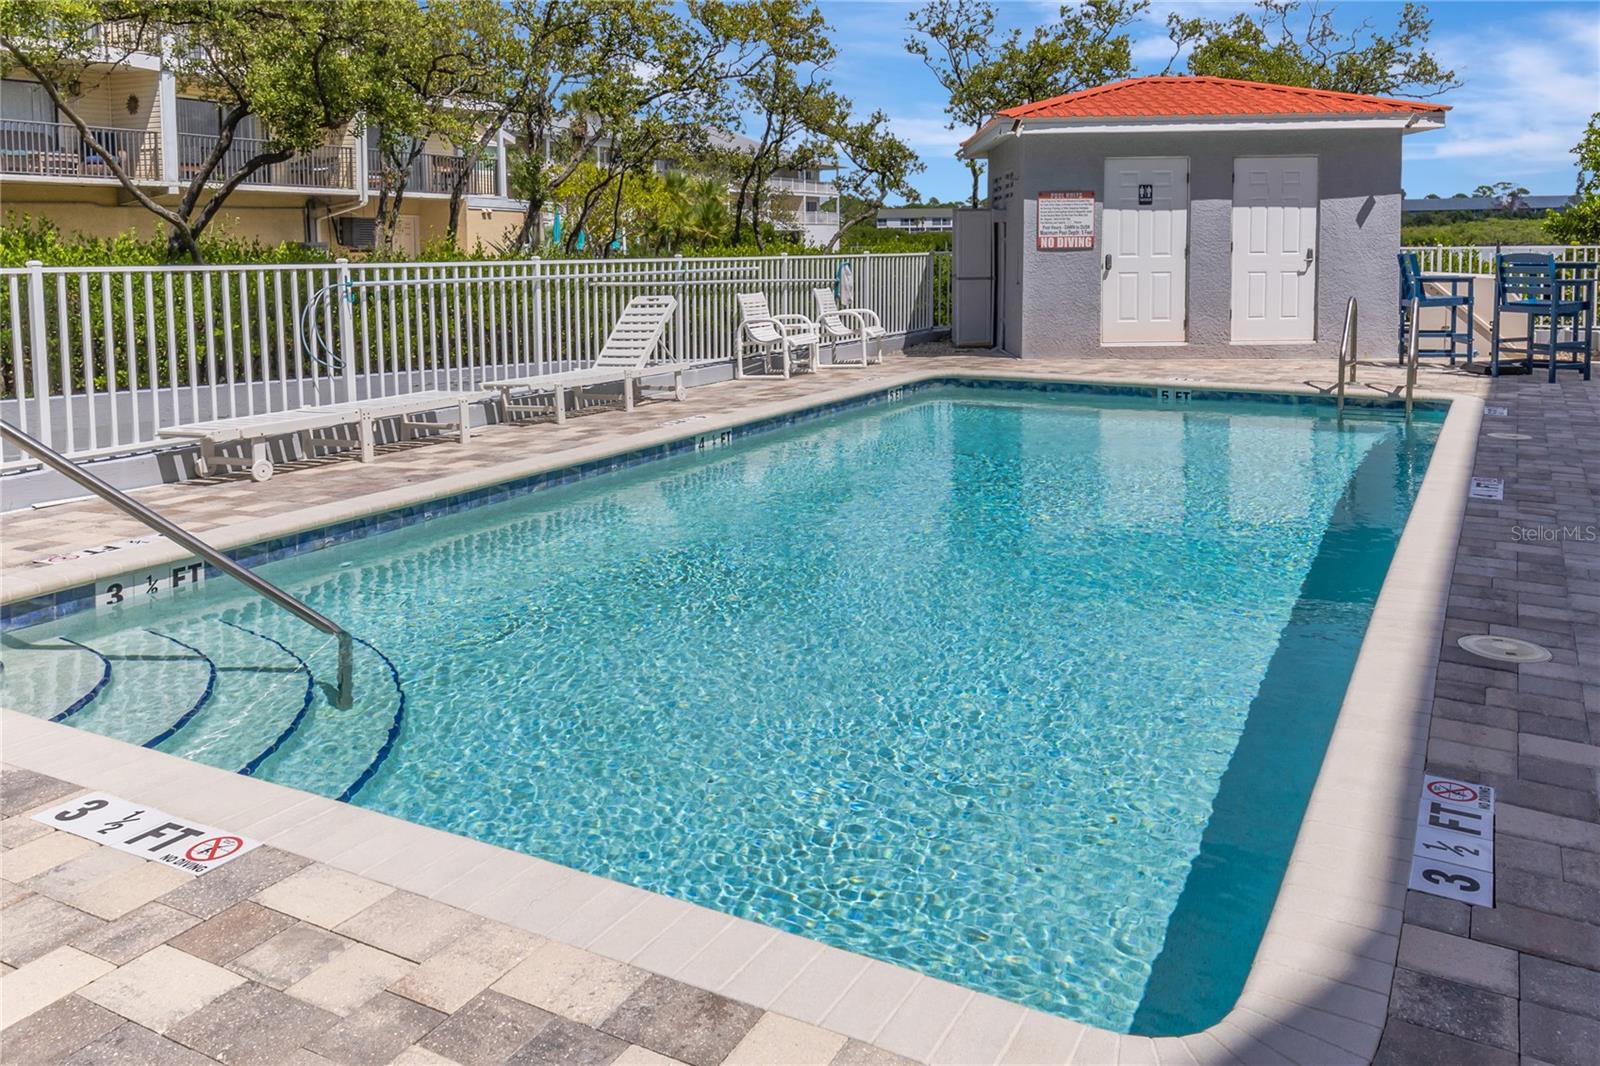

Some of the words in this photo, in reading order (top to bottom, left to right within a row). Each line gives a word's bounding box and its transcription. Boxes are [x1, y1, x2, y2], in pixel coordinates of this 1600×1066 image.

[1040, 237, 1055, 248] NO
[1057, 237, 1092, 248] DIVING
[1161, 390, 1169, 399] 5
[1175, 391, 1190, 400] FT
[720, 430, 732, 443] FT
[106, 583, 124, 605] 3
[172, 562, 202, 588] FT
[54, 799, 109, 822] 3
[123, 821, 206, 853] FT
[1428, 801, 1482, 836] FT
[159, 853, 178, 864] NO
[172, 855, 208, 873] DIVING
[1422, 868, 1481, 892] 3
